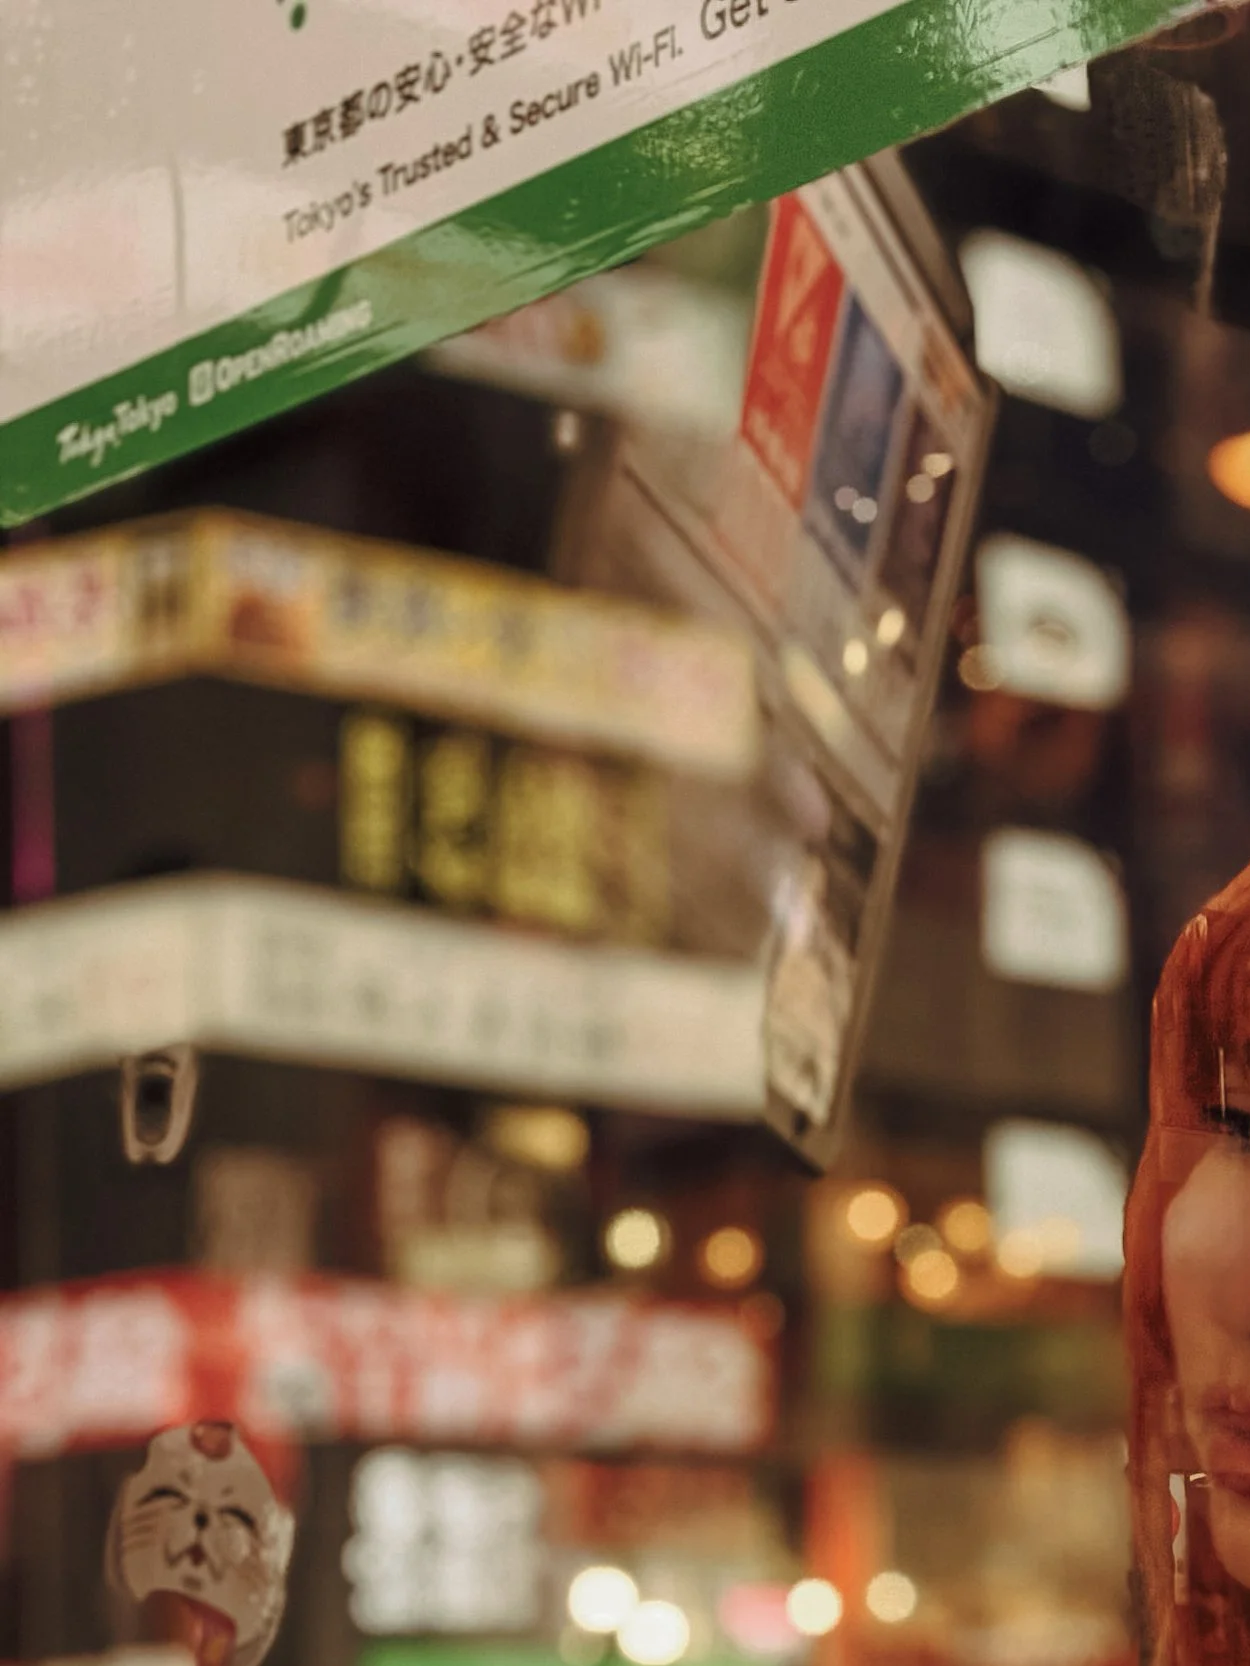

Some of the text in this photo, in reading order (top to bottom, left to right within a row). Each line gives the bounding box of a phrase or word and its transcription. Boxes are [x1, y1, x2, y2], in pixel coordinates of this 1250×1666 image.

[284, 182, 371, 243] Tokyo's
[377, 126, 472, 197] Trusted
[480, 114, 501, 150] &
[509, 72, 600, 135] Secure
[608, 25, 683, 87] Wi-Fi.
